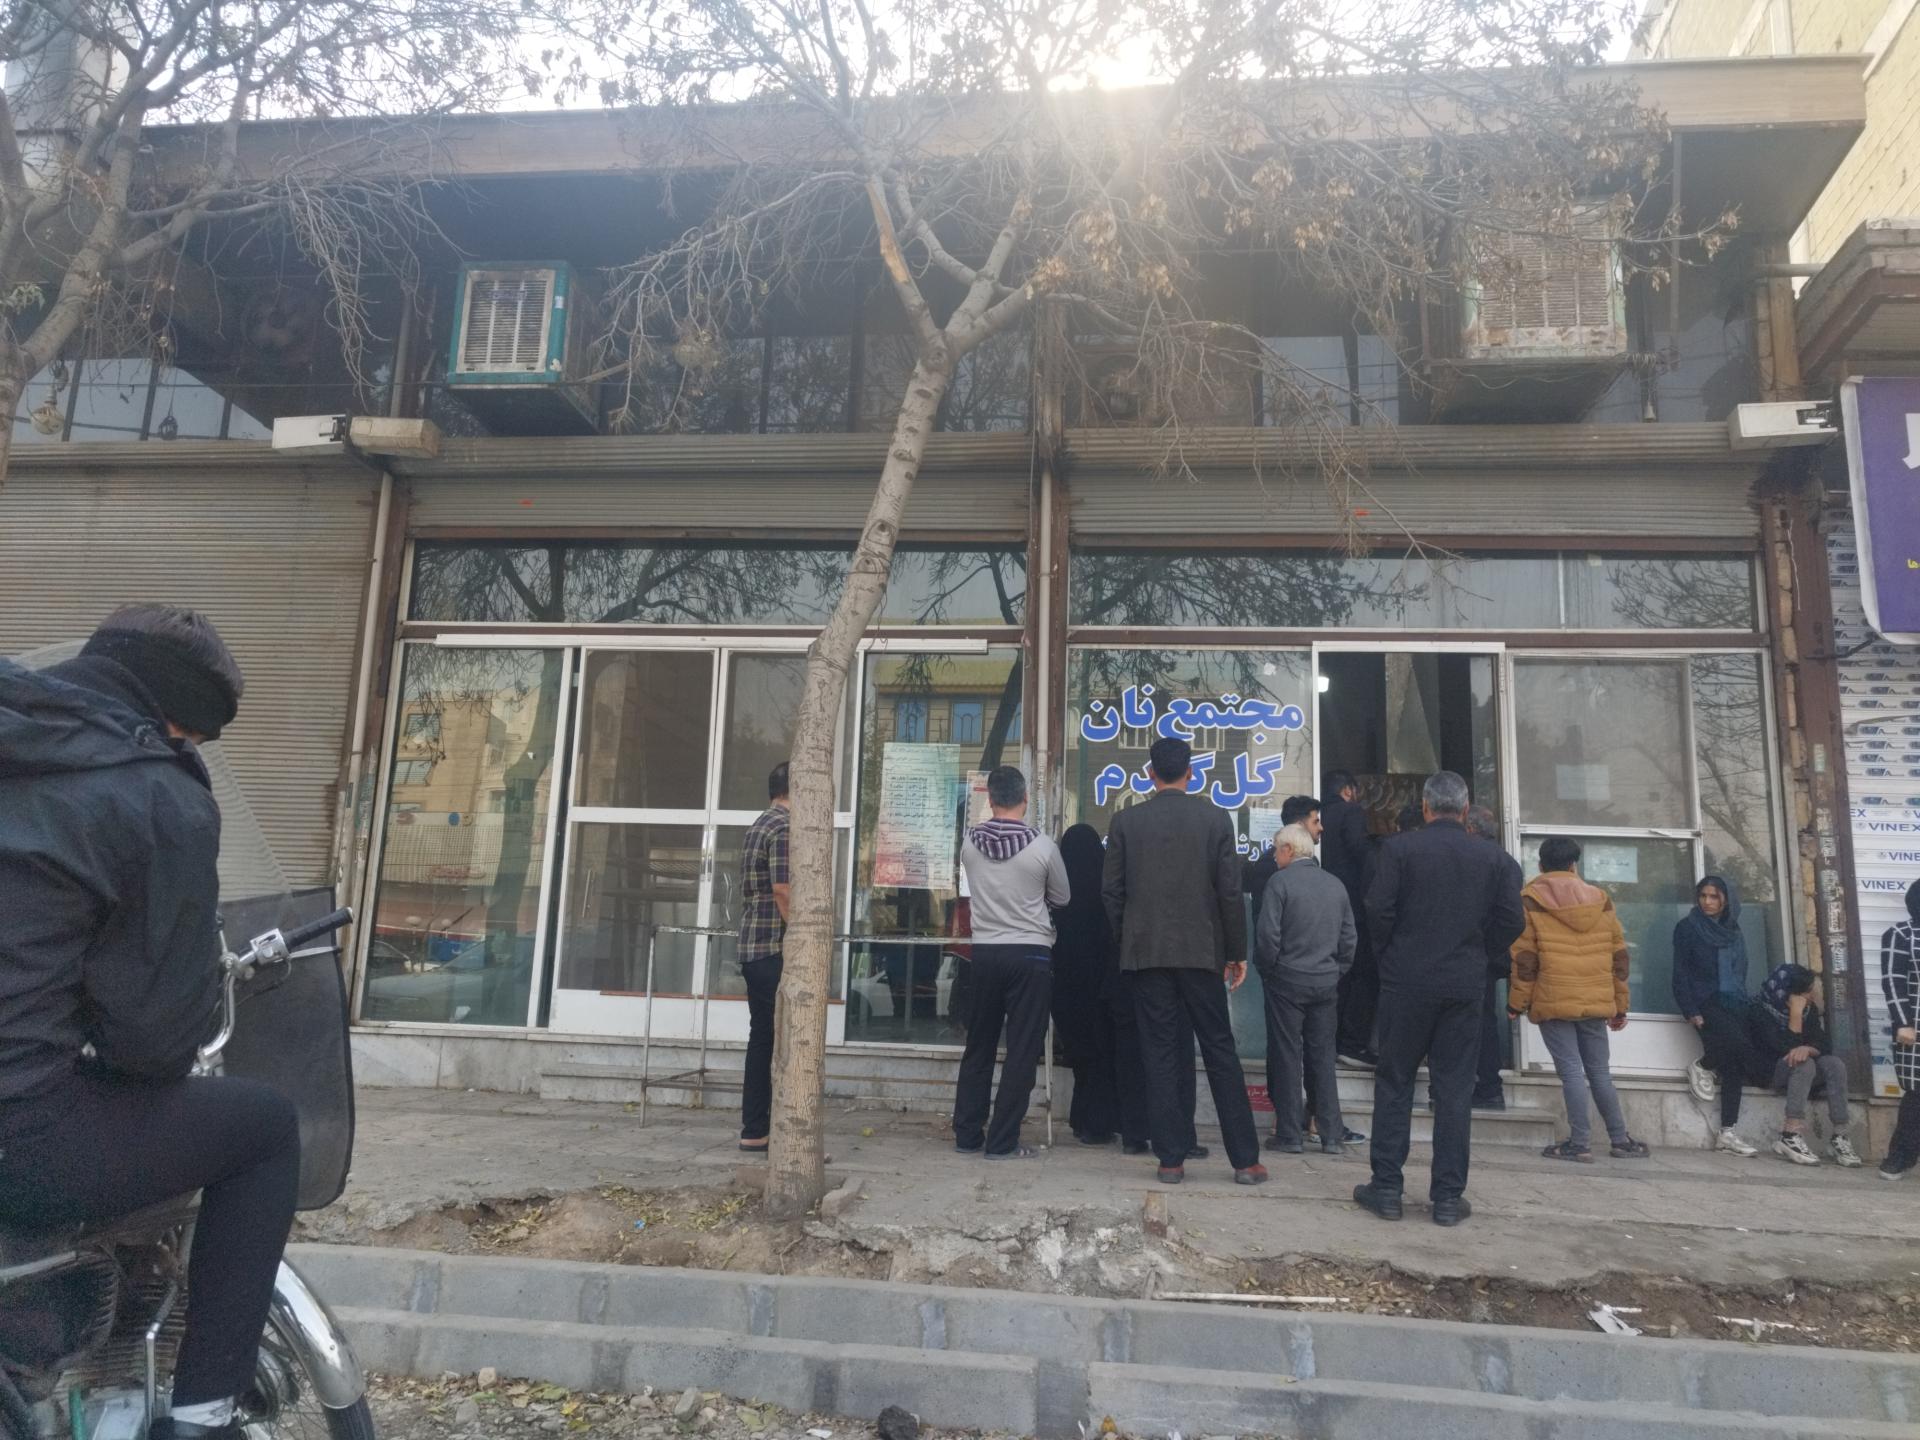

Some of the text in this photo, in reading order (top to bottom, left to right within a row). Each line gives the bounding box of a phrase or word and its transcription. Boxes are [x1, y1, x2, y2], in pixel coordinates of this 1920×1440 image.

[1081, 683, 1304, 744] مجتمع نان
[1095, 751, 1216, 806] گدم
[1211, 752, 1284, 809] گل
[1888, 851, 1920, 861] VINE
[1861, 880, 1906, 891] VINEX
